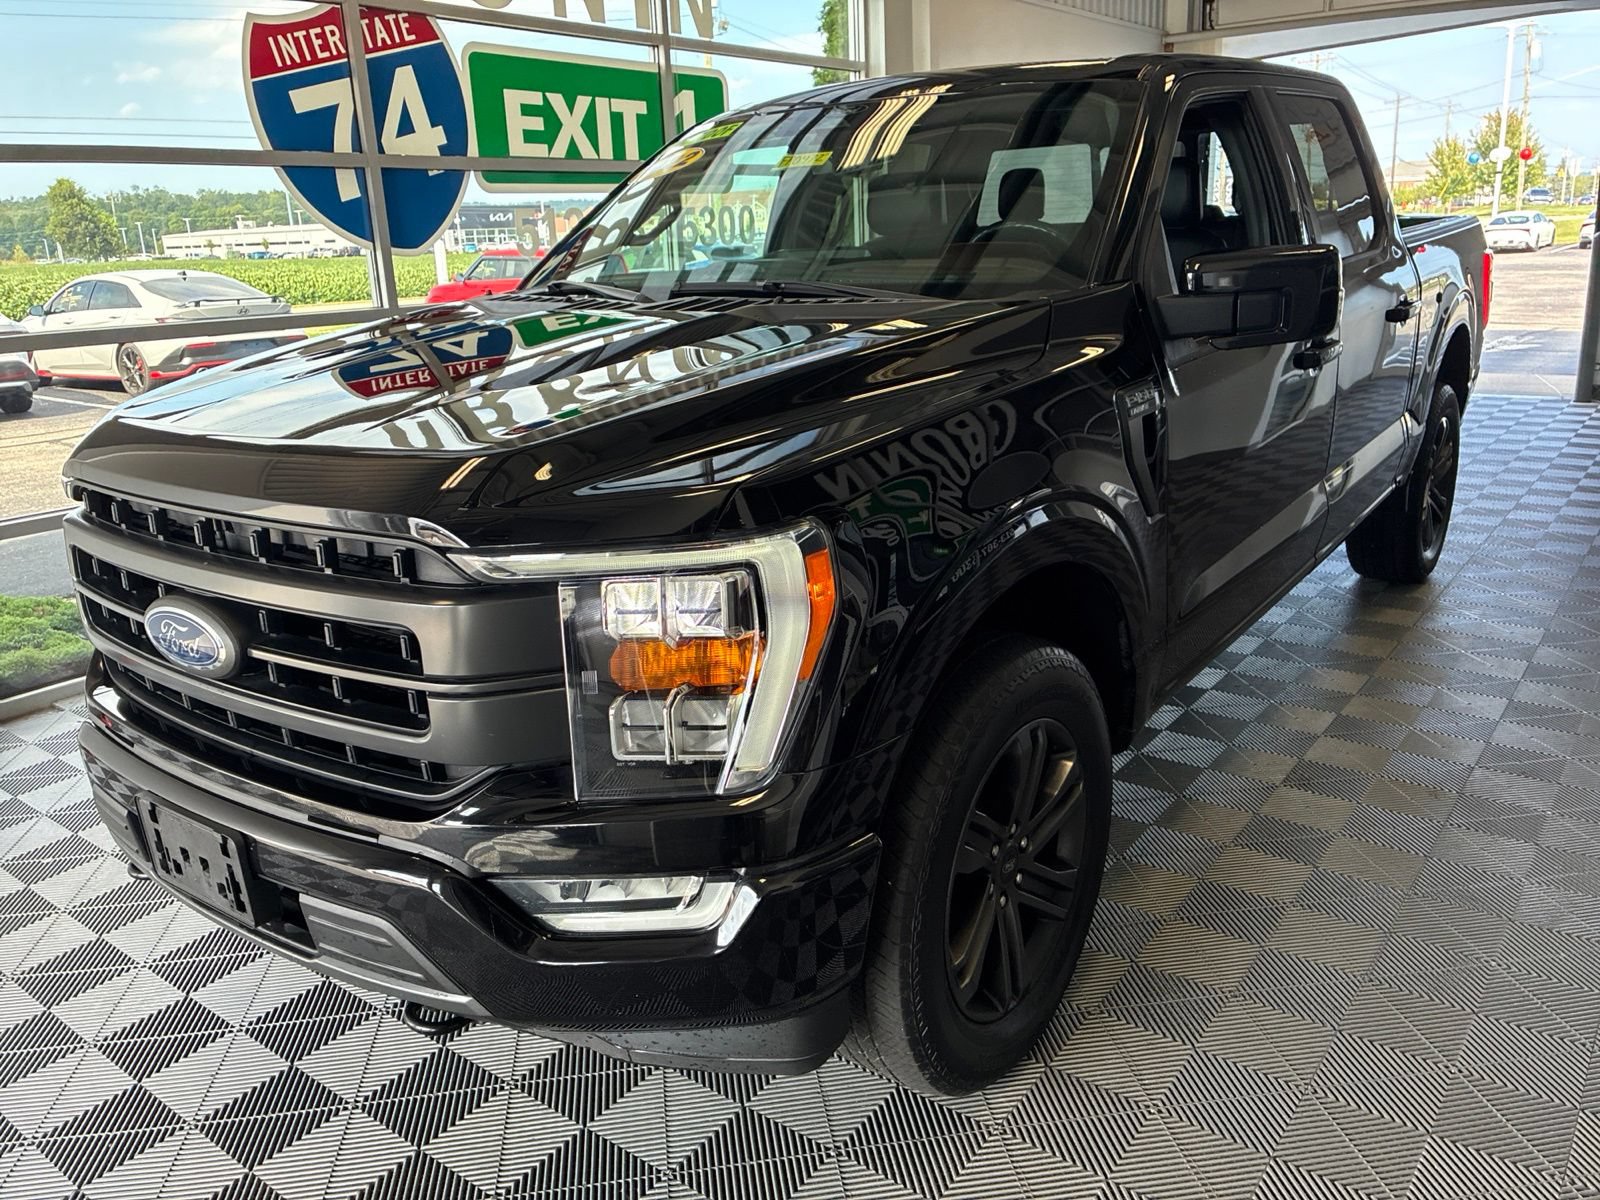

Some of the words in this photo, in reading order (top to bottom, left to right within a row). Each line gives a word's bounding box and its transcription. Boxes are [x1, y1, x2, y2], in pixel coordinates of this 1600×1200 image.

[268, 13, 417, 67] INTERTATE
[289, 65, 448, 203] 74
[503, 88, 648, 161] EXIT
[673, 89, 697, 131] 1
[158, 619, 202, 659] Ford
